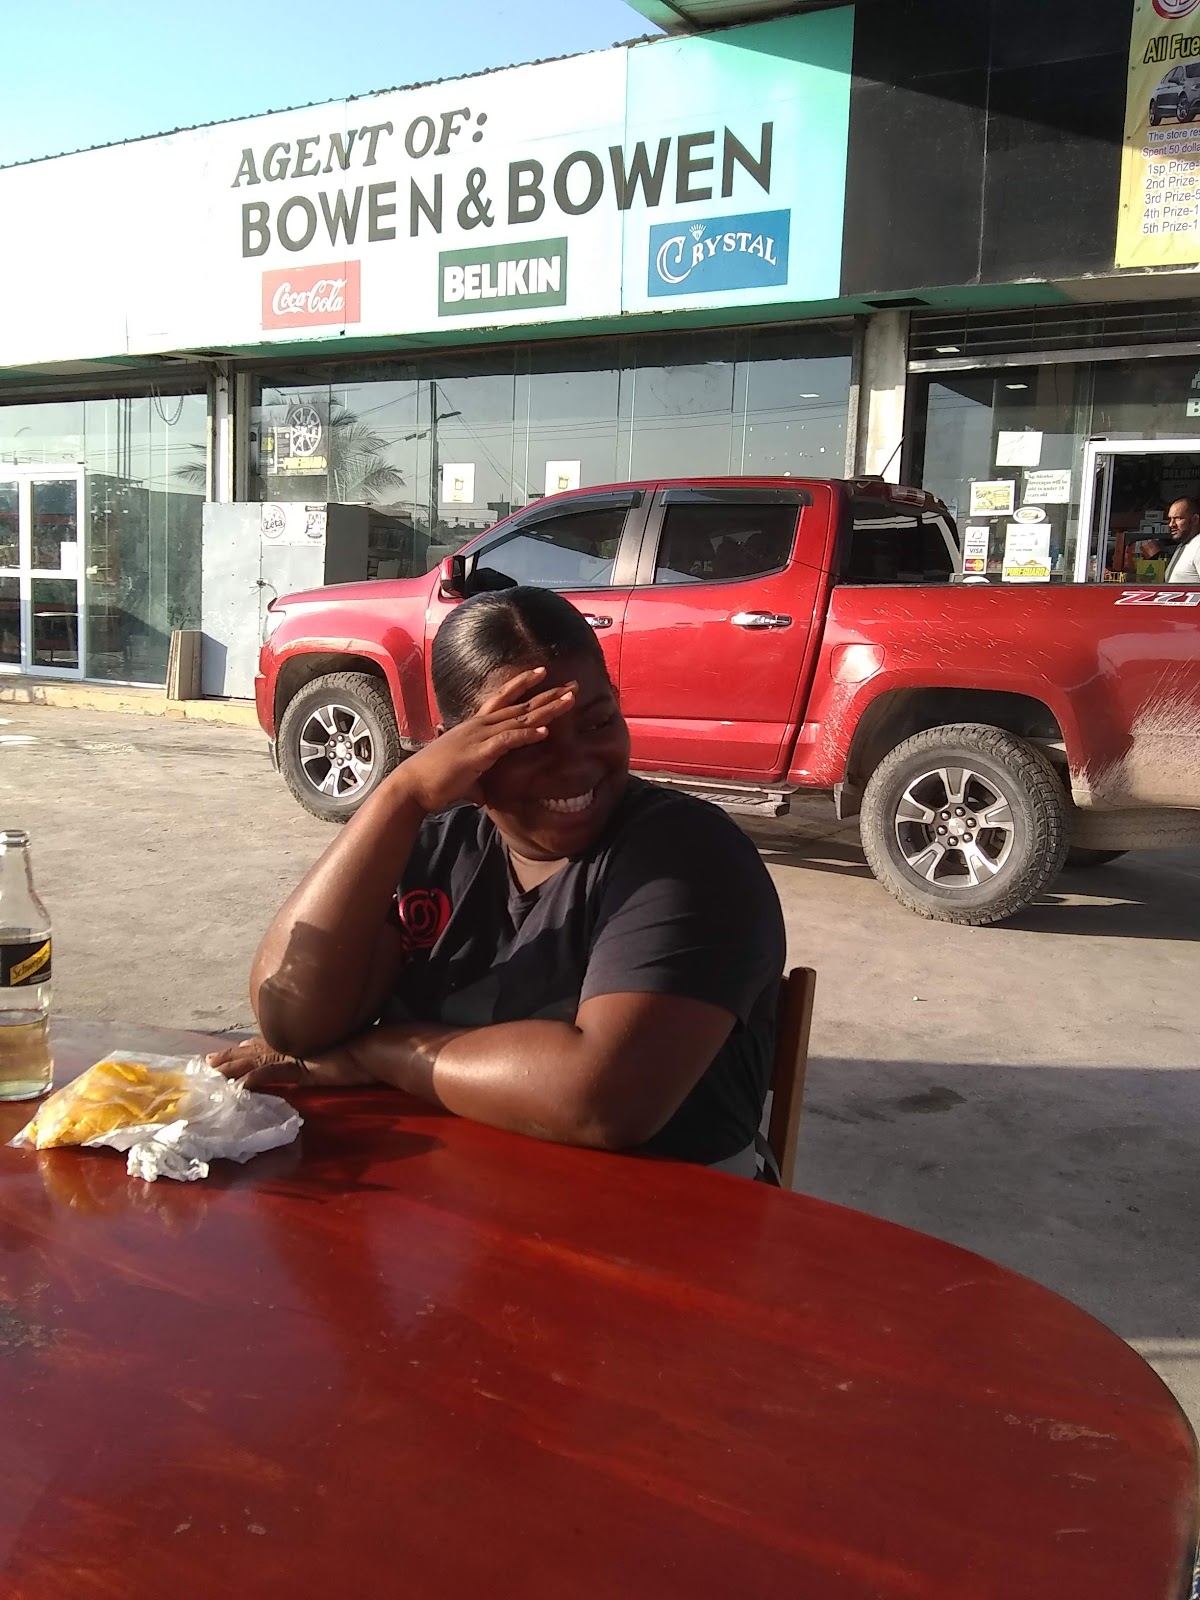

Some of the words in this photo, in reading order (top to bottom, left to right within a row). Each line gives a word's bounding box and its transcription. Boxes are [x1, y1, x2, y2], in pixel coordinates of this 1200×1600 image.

[1143, 36, 1168, 64] All
[1148, 132, 1164, 142] The
[1166, 129, 1187, 139] store
[230, 121, 393, 188] AGENT
[404, 107, 488, 159] OF:
[1142, 146, 1167, 158] Spent
[1169, 144, 1179, 154] 50
[1147, 164, 1165, 176] 1sp
[242, 173, 442, 258] BOWEN
[457, 167, 495, 230] &
[507, 121, 774, 225] BOWEN
[1146, 178, 1165, 189] 2nd
[1145, 193, 1161, 204] 3rd
[1144, 207, 1160, 219] 4th
[1163, 204, 1199, 217] Prize-1
[1143, 223, 1159, 234] 5th
[1162, 219, 1198, 232] Prize-1
[656, 231, 777, 284] CRYSTAL
[443, 256, 561, 303] BELIKIN
[272, 278, 348, 315] Coca-Cola
